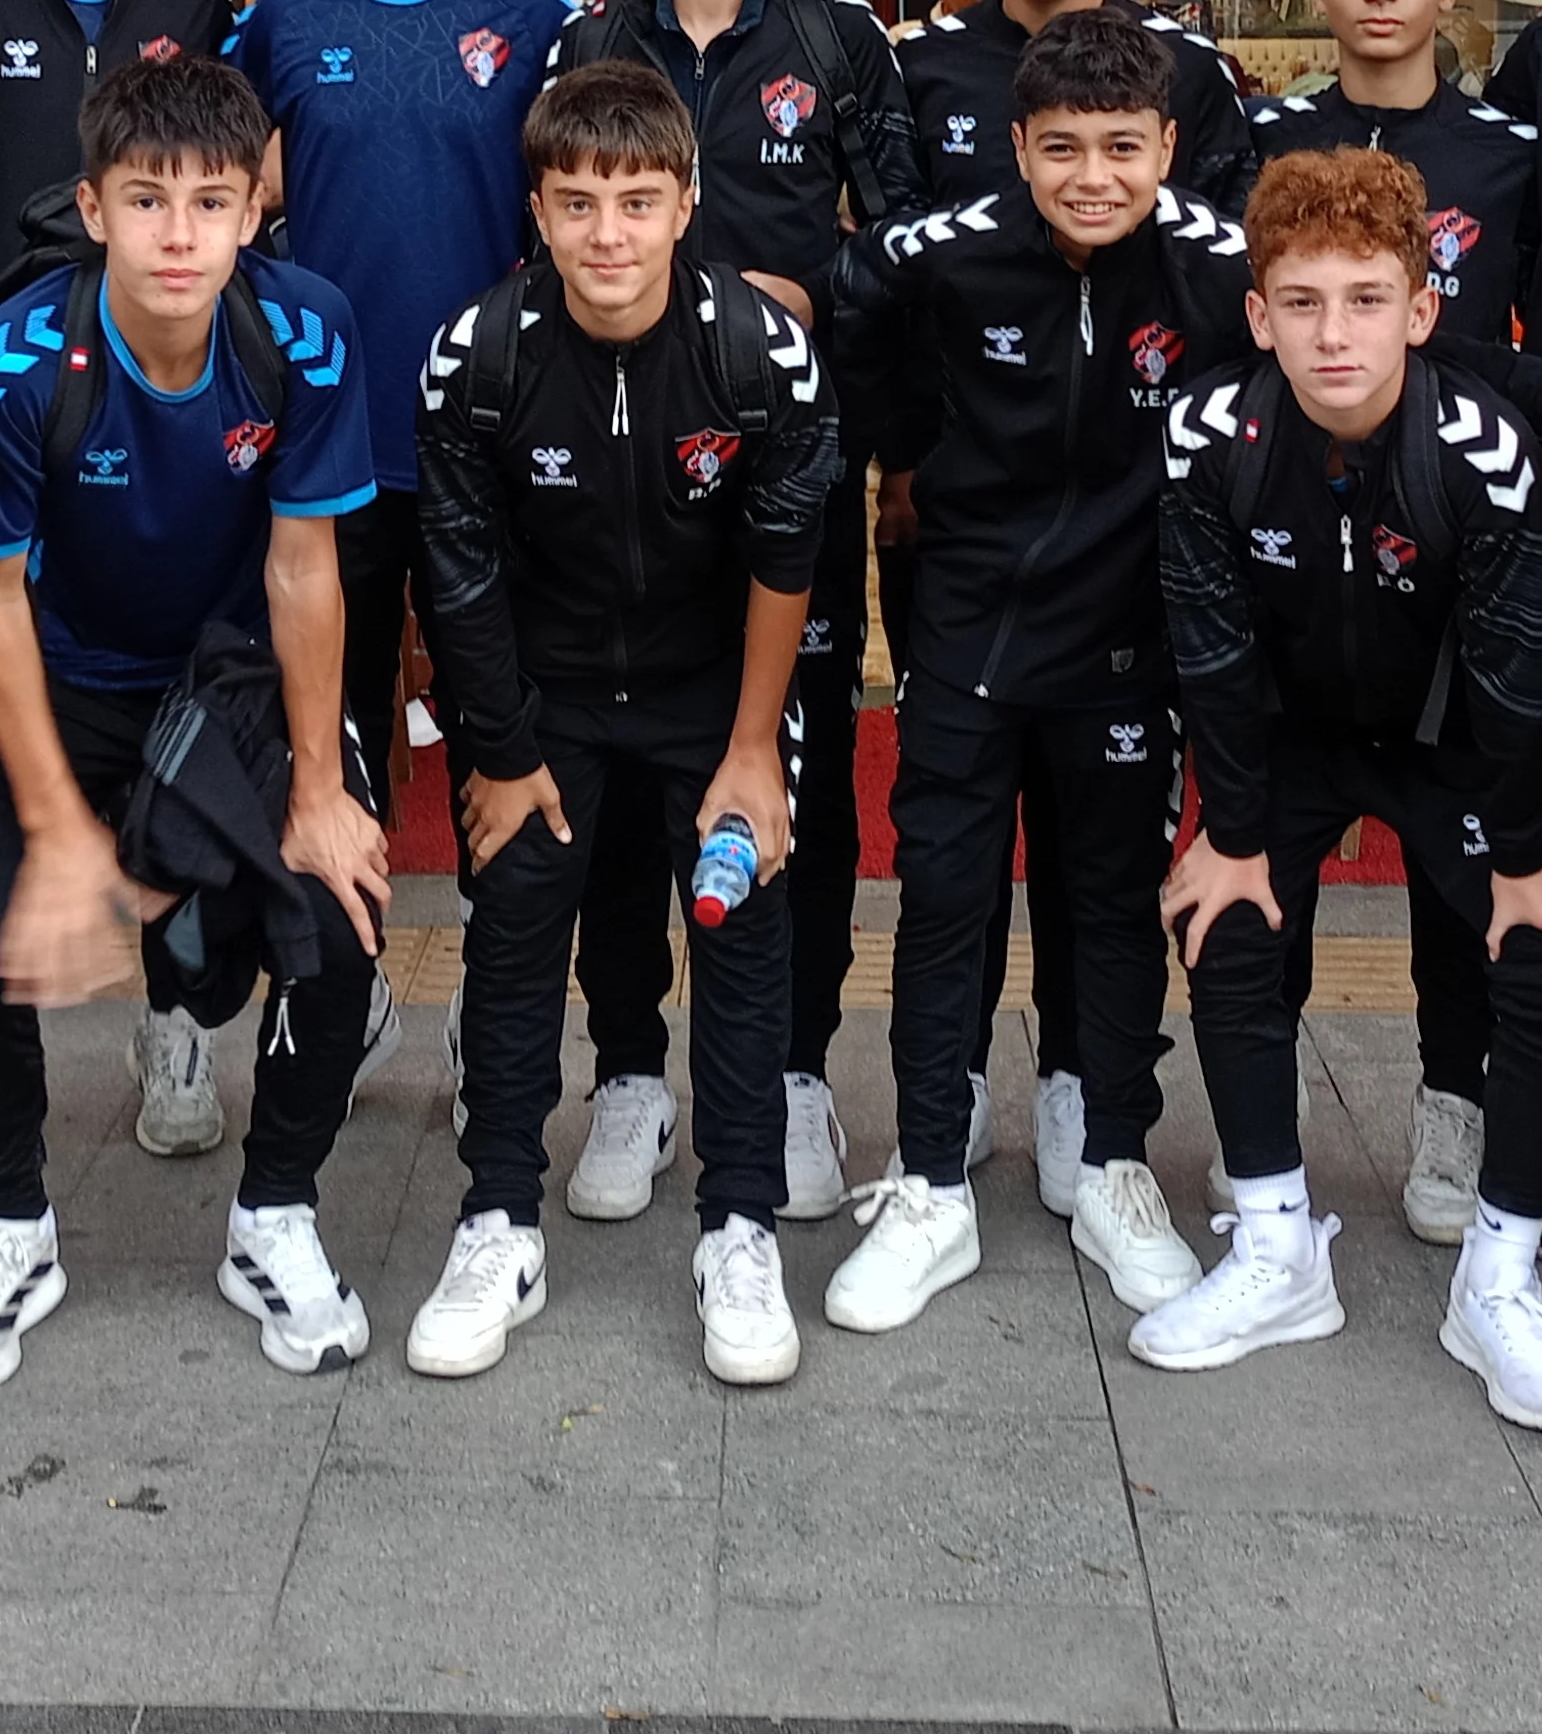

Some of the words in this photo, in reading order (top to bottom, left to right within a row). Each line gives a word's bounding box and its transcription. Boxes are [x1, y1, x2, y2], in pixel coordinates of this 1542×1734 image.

[531, 471, 577, 487] hummel
[1250, 546, 1296, 569] hummel
[1105, 746, 1148, 763] hummel
